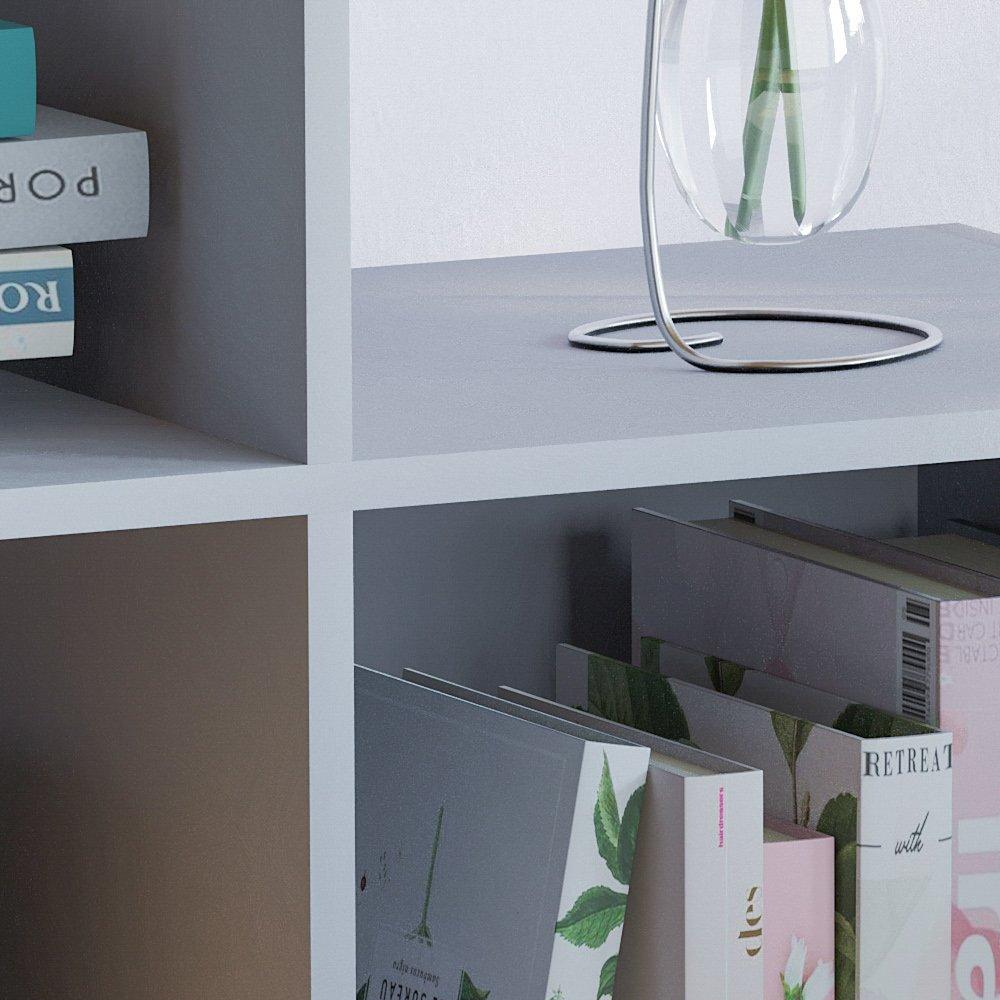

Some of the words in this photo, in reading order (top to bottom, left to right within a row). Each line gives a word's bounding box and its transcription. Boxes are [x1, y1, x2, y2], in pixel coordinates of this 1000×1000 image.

[0, 166, 99, 203] POR
[0, 280, 62, 313] RO
[863, 743, 952, 777] RETREAT
[895, 811, 930, 855] with
